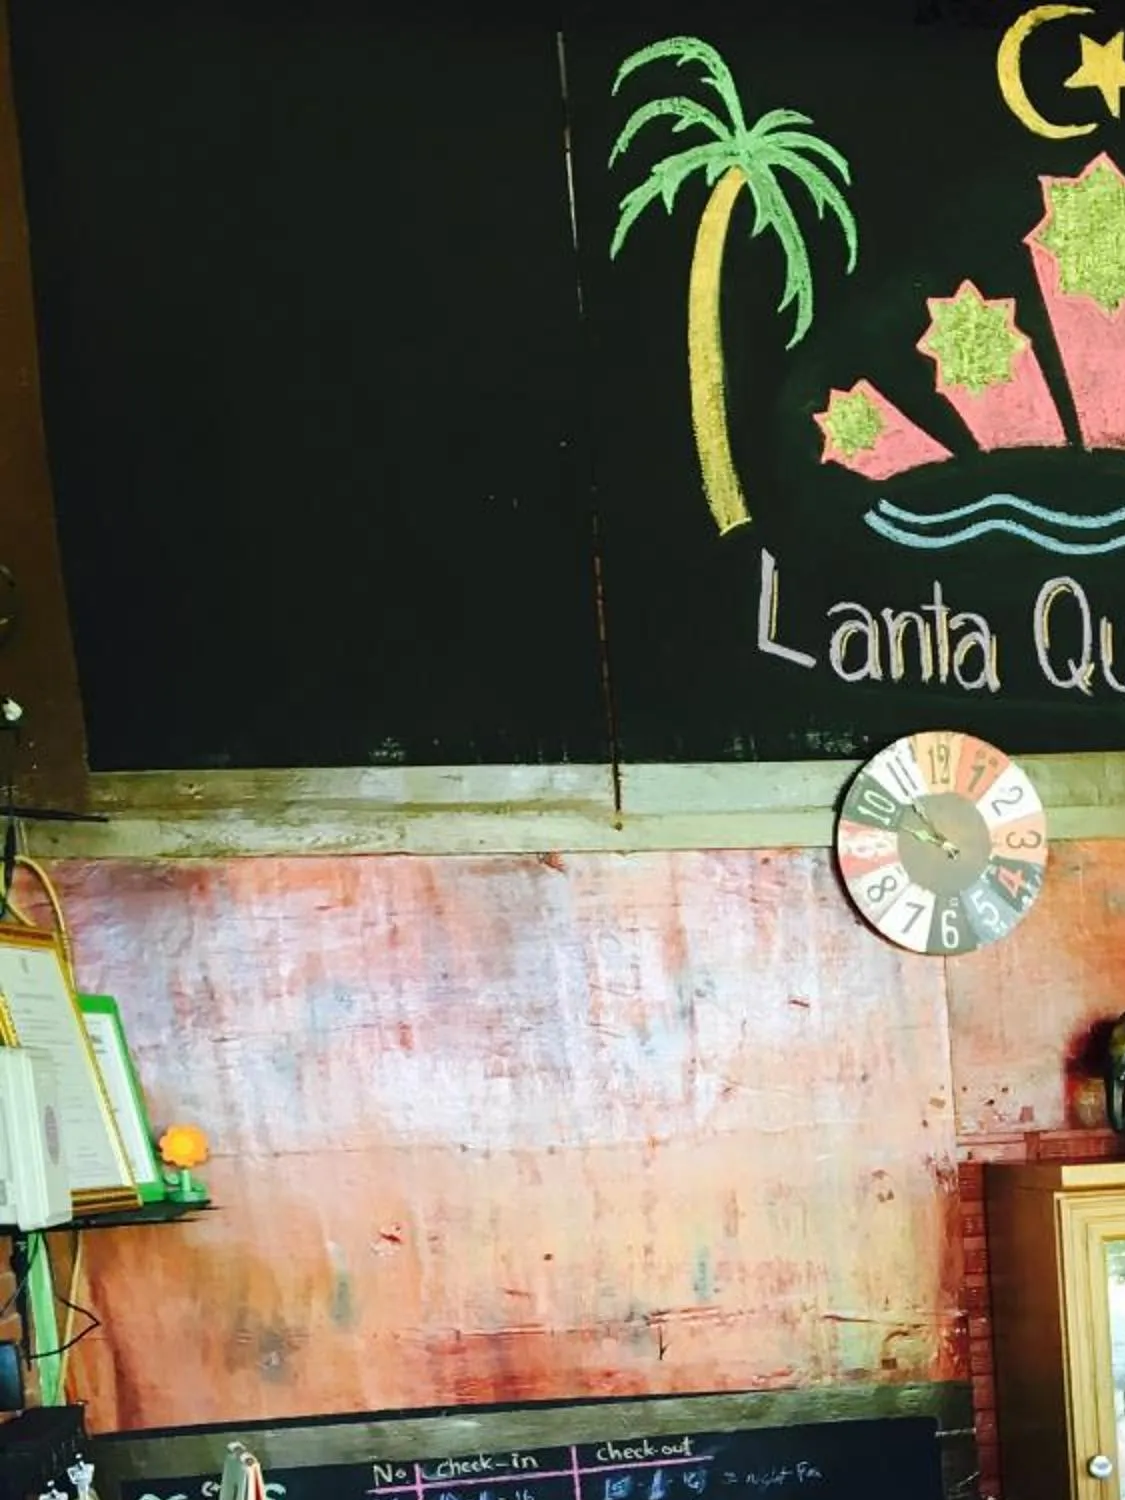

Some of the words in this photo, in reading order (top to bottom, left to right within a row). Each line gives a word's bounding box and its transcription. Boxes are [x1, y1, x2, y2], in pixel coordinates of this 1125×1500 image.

[758, 547, 1000, 694] Lanta
[927, 744, 951, 785] 12
[967, 765, 986, 792] 1
[856, 790, 896, 826] 10
[991, 785, 1024, 817] 2
[1005, 830, 1043, 849] 3
[867, 875, 897, 903] 8
[998, 866, 1029, 897] 4
[902, 901, 926, 934] 7
[971, 889, 1000, 926] 5
[940, 909, 959, 949] 6
